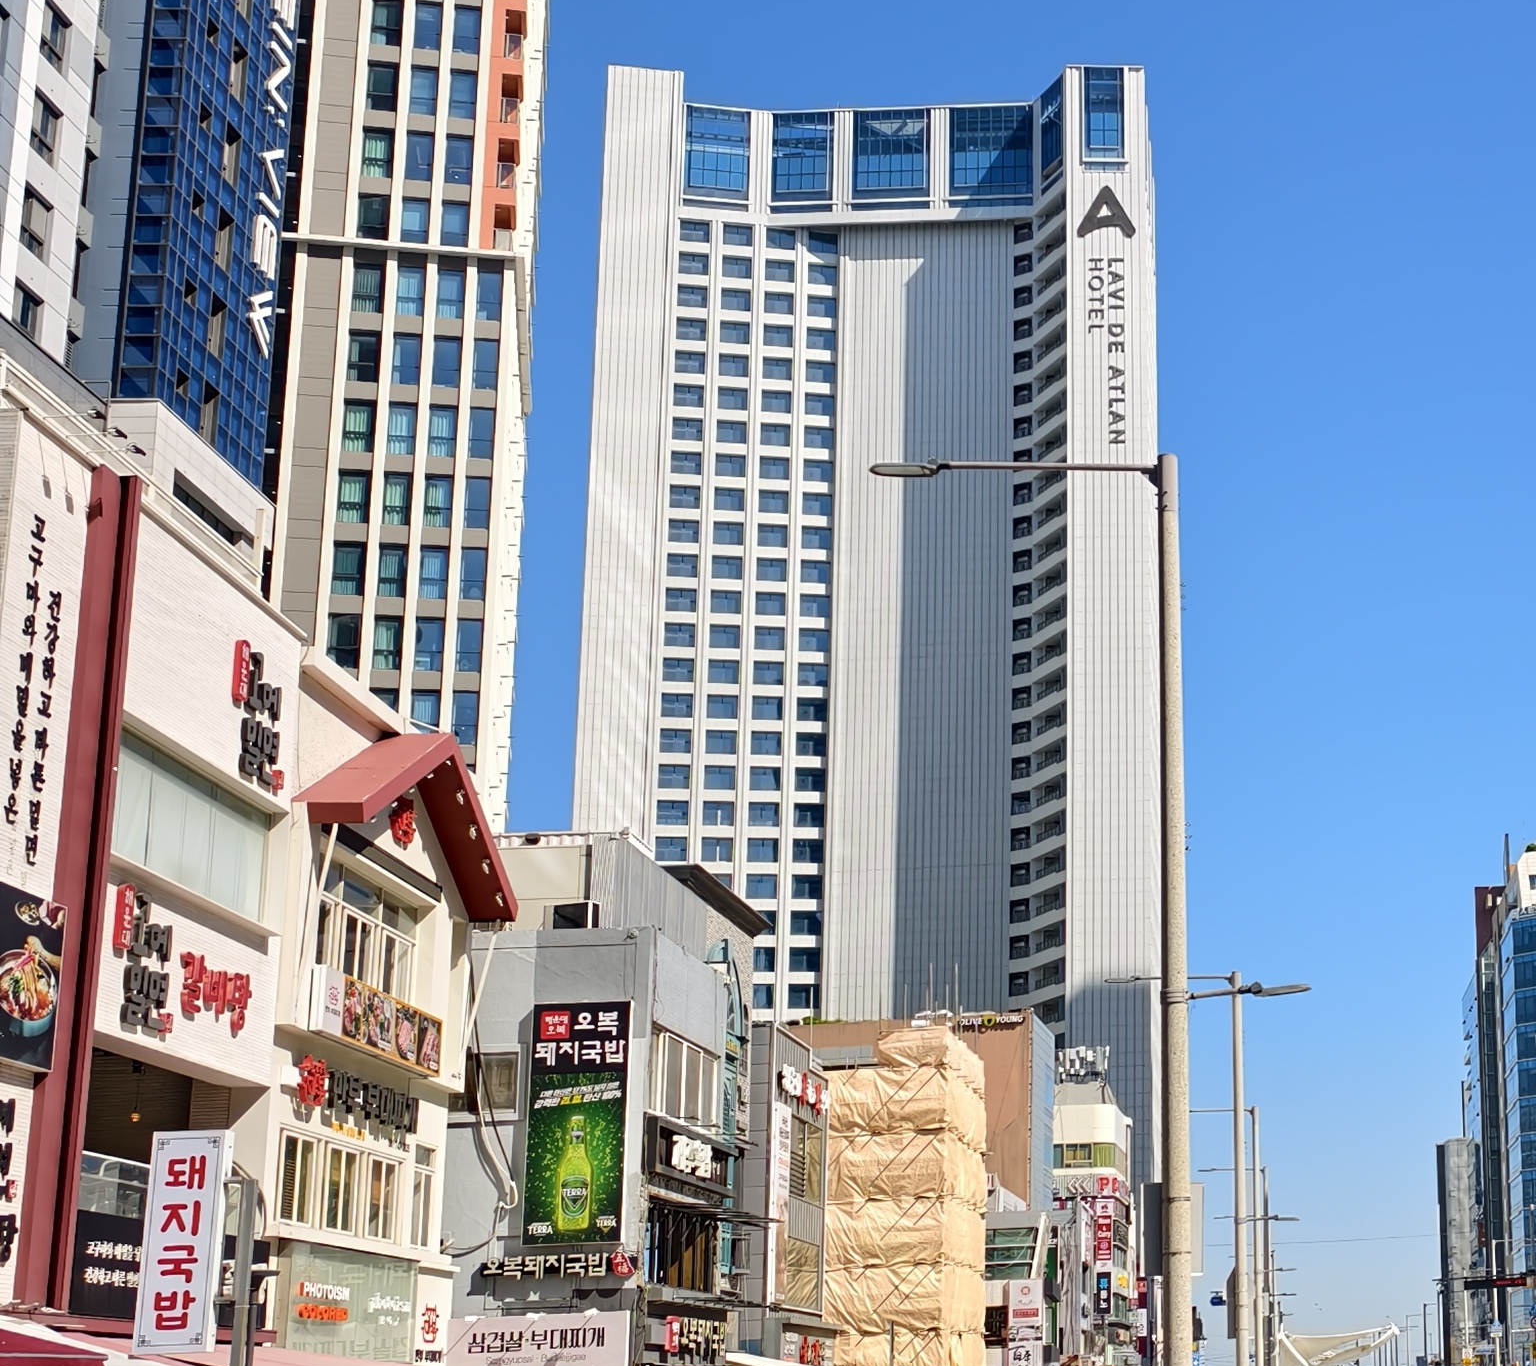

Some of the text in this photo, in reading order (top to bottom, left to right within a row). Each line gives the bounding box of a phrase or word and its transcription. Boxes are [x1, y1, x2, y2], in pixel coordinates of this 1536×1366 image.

[247, 147, 286, 360] VIEW
[1087, 257, 1105, 335] HOTEL
[1107, 258, 1125, 445] LAVI DE ATLAN
[22, 514, 46, 648] 고구마와
[37, 591, 62, 718] 건강하고
[180, 951, 252, 1032] 갈비탕
[573, 1011, 619, 1036] 오복
[958, 1014, 1024, 1026] OLIVE YOUNG
[534, 1039, 626, 1066] 돼지국밥
[562, 1187, 588, 1198] TERRA
[527, 1225, 554, 1235] TERRA
[595, 1218, 617, 1228] TERRA
[153, 1154, 207, 1332] 돼지국밥
[482, 1251, 610, 1280] 오복돼지국밥
[302, 1282, 350, 1302] PHOTOISM
